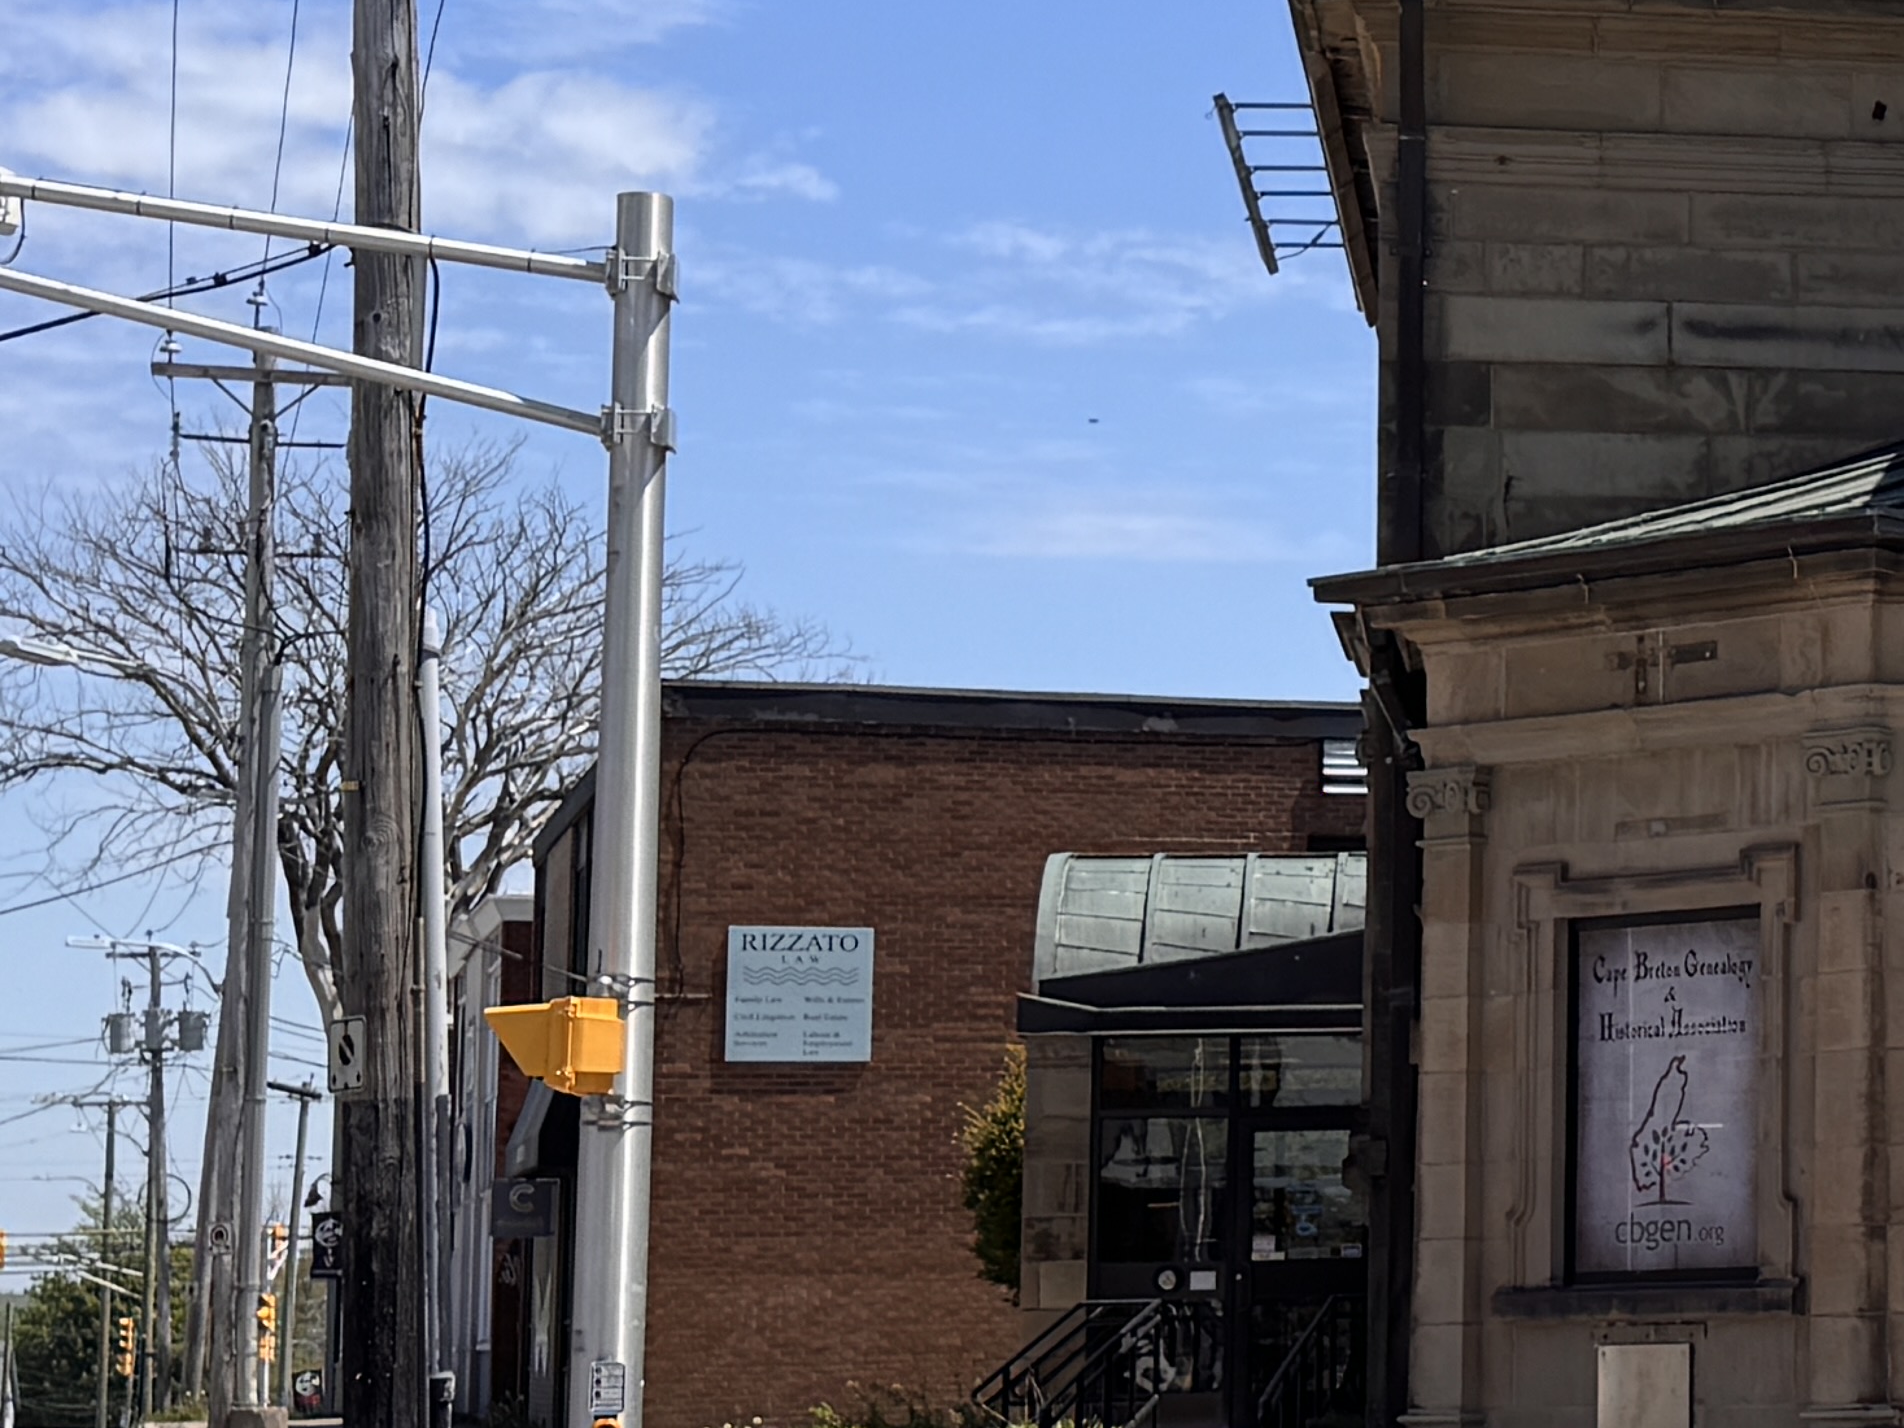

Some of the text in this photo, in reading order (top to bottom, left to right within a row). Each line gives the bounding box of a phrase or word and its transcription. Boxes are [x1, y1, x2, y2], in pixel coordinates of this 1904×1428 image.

[742, 933, 860, 953] RIZZATO
[782, 954, 820, 964] LAW
[1593, 949, 1753, 998] Cape Breton Genealogy
[1664, 986, 1677, 1003] &
[1599, 1005, 1746, 1042] Historical Association
[1614, 1211, 1725, 1251] cbgen.org
